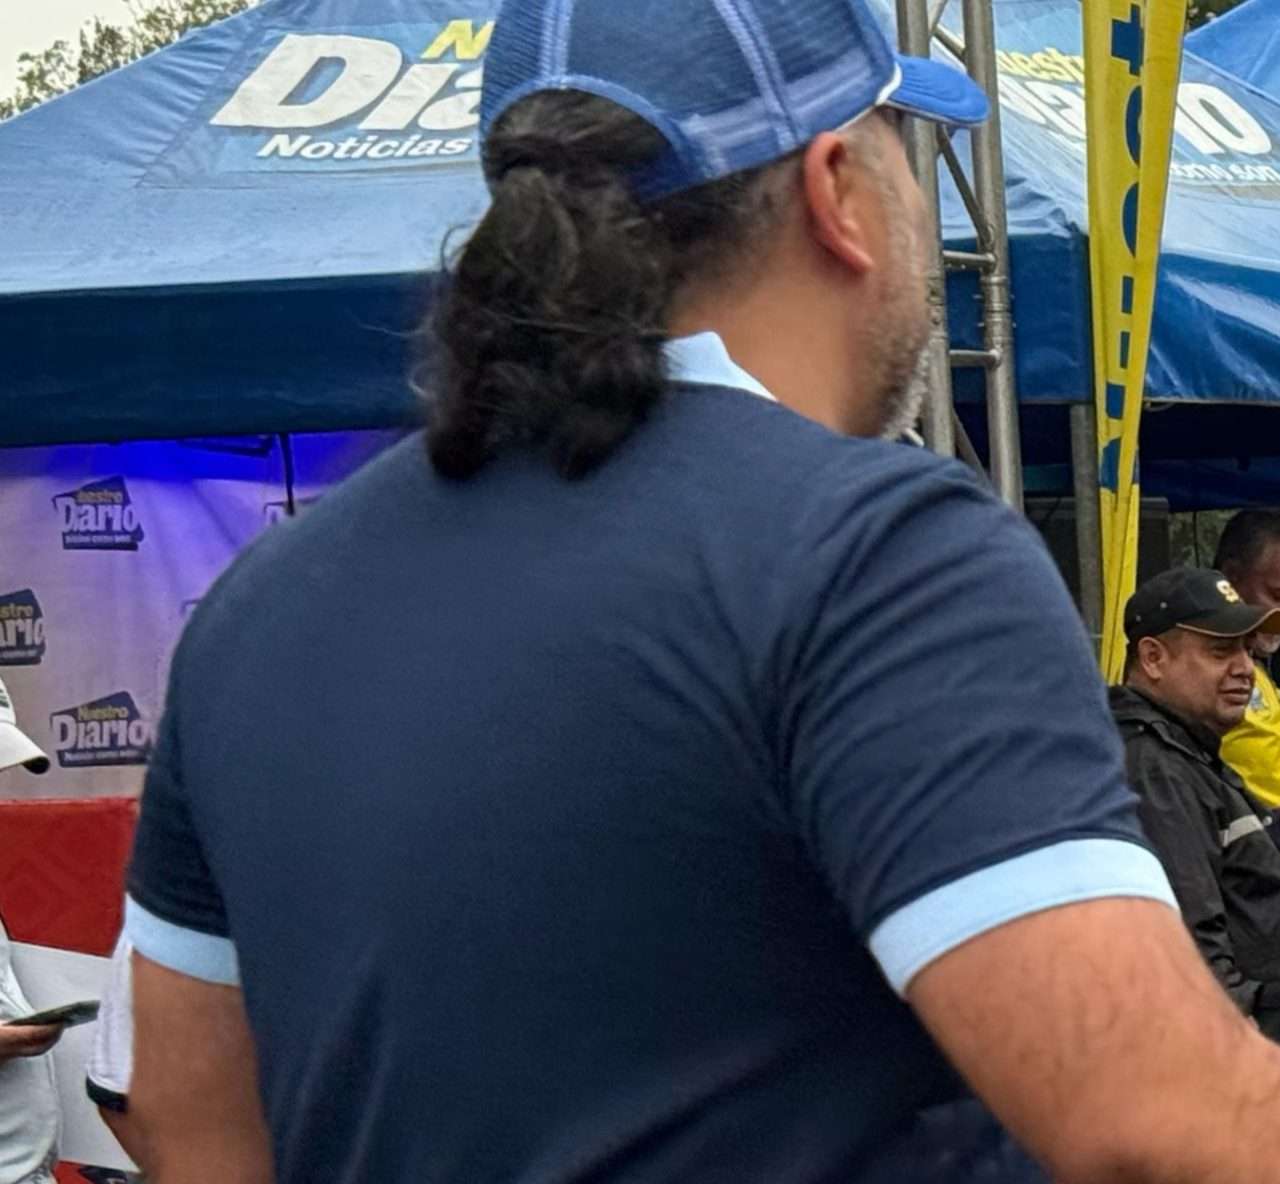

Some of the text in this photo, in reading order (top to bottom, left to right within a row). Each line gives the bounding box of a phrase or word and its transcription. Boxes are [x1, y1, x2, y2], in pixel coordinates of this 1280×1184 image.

[208, 32, 486, 132] Dia
[256, 133, 474, 160] Noticias
[52, 714, 150, 751] Diario
